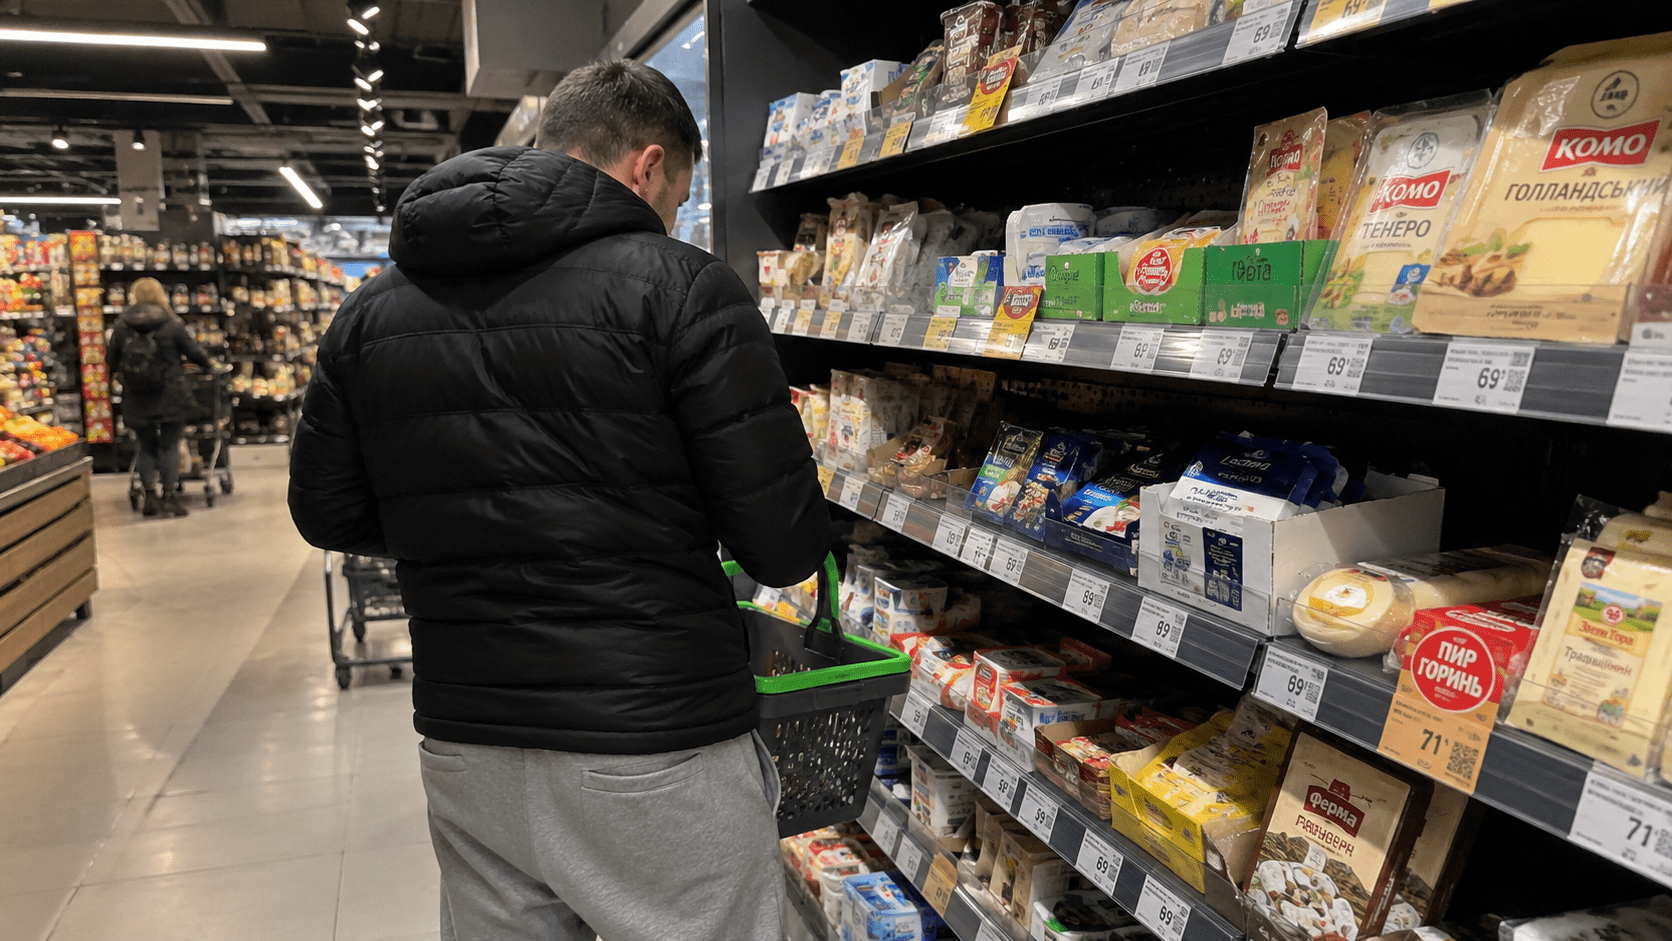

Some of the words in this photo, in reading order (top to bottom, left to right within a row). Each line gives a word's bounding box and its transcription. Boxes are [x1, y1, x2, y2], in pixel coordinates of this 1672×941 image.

[1554, 133, 1647, 160] КОМО
[1378, 180, 1440, 203] КОМО
[1362, 219, 1431, 240] ТЕНЕРО
[1327, 356, 1346, 376] 69
[1477, 367, 1500, 390] 69
[1155, 620, 1171, 639] 89
[1437, 640, 1478, 669] ПИР
[1417, 656, 1483, 699] ГОРИНЬ
[1309, 791, 1358, 828] Ферма
